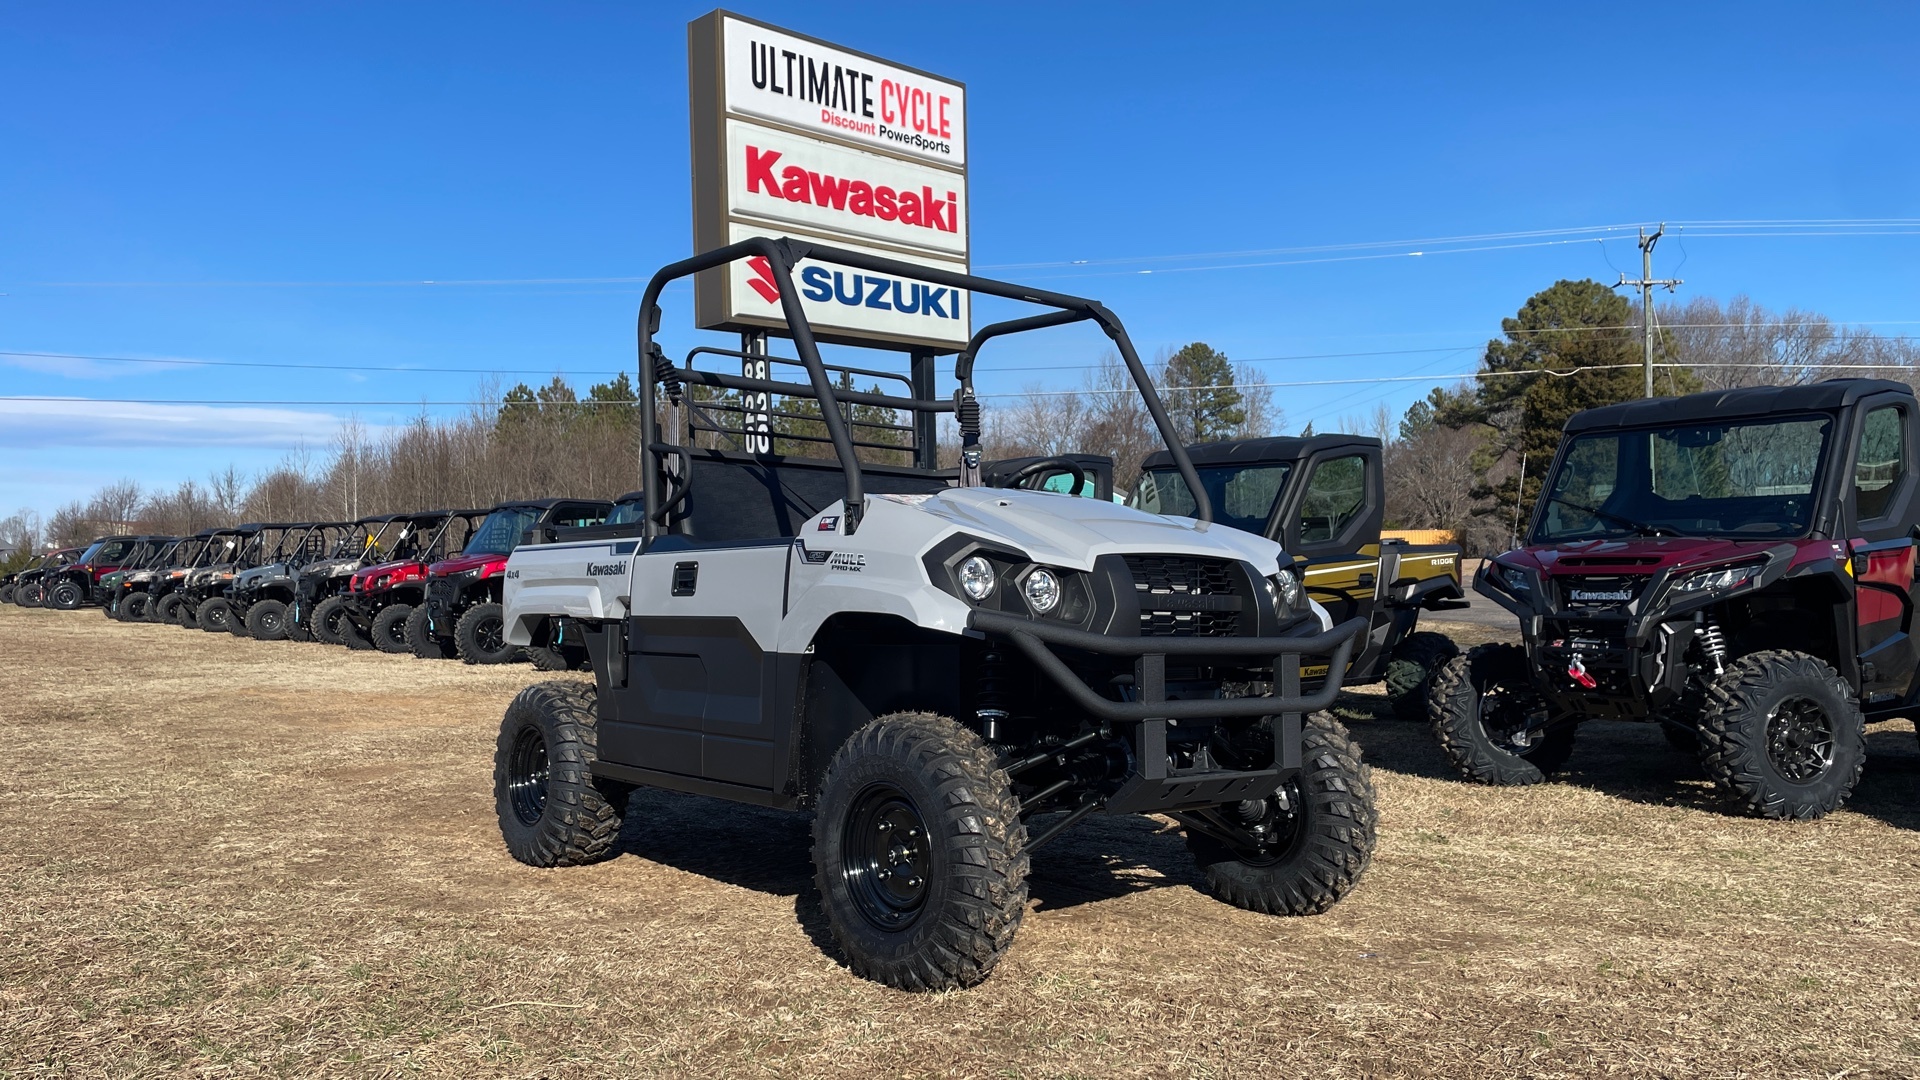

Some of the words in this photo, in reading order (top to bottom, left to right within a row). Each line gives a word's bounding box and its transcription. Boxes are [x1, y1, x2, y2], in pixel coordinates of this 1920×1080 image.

[751, 40, 874, 119] ULTIMATE
[881, 78, 951, 139] CYCLE
[821, 109, 876, 135] Discount
[879, 124, 950, 154] PowerSports
[745, 144, 957, 234] Kawasaki
[801, 265, 960, 320] SUZUKI
[829, 552, 866, 566] MULE
[1431, 557, 1454, 566] RIDGE
[506, 570, 520, 579] 4x4
[586, 561, 627, 576] Kawasaki
[1570, 589, 1633, 600] Kawasaki
[1304, 667, 1328, 676] Kawas
